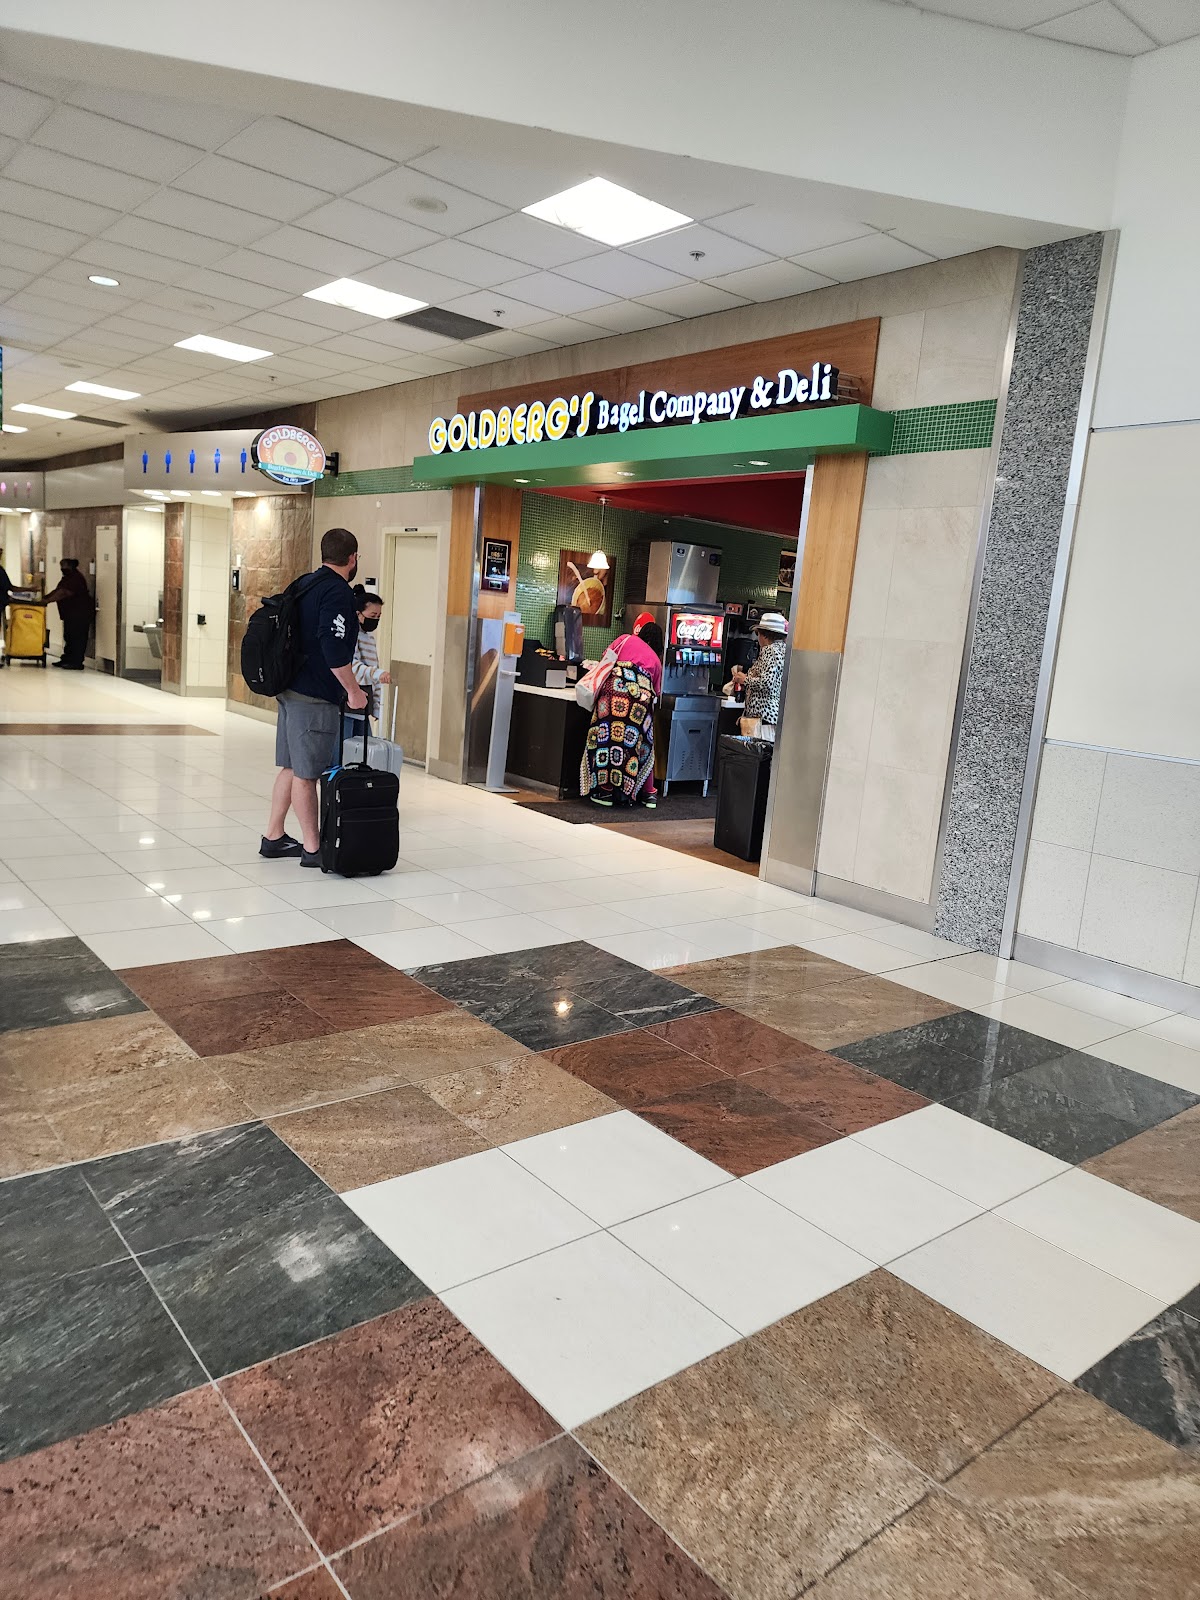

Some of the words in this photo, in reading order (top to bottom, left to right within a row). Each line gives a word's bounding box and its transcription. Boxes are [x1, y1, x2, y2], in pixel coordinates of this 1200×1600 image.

[428, 392, 595, 454] GOLDBERG'S
[597, 391, 645, 431] Bagel
[650, 386, 746, 424] Company
[750, 376, 773, 409] &
[777, 362, 832, 405] Deli
[263, 428, 322, 458] GOLDBERG'S
